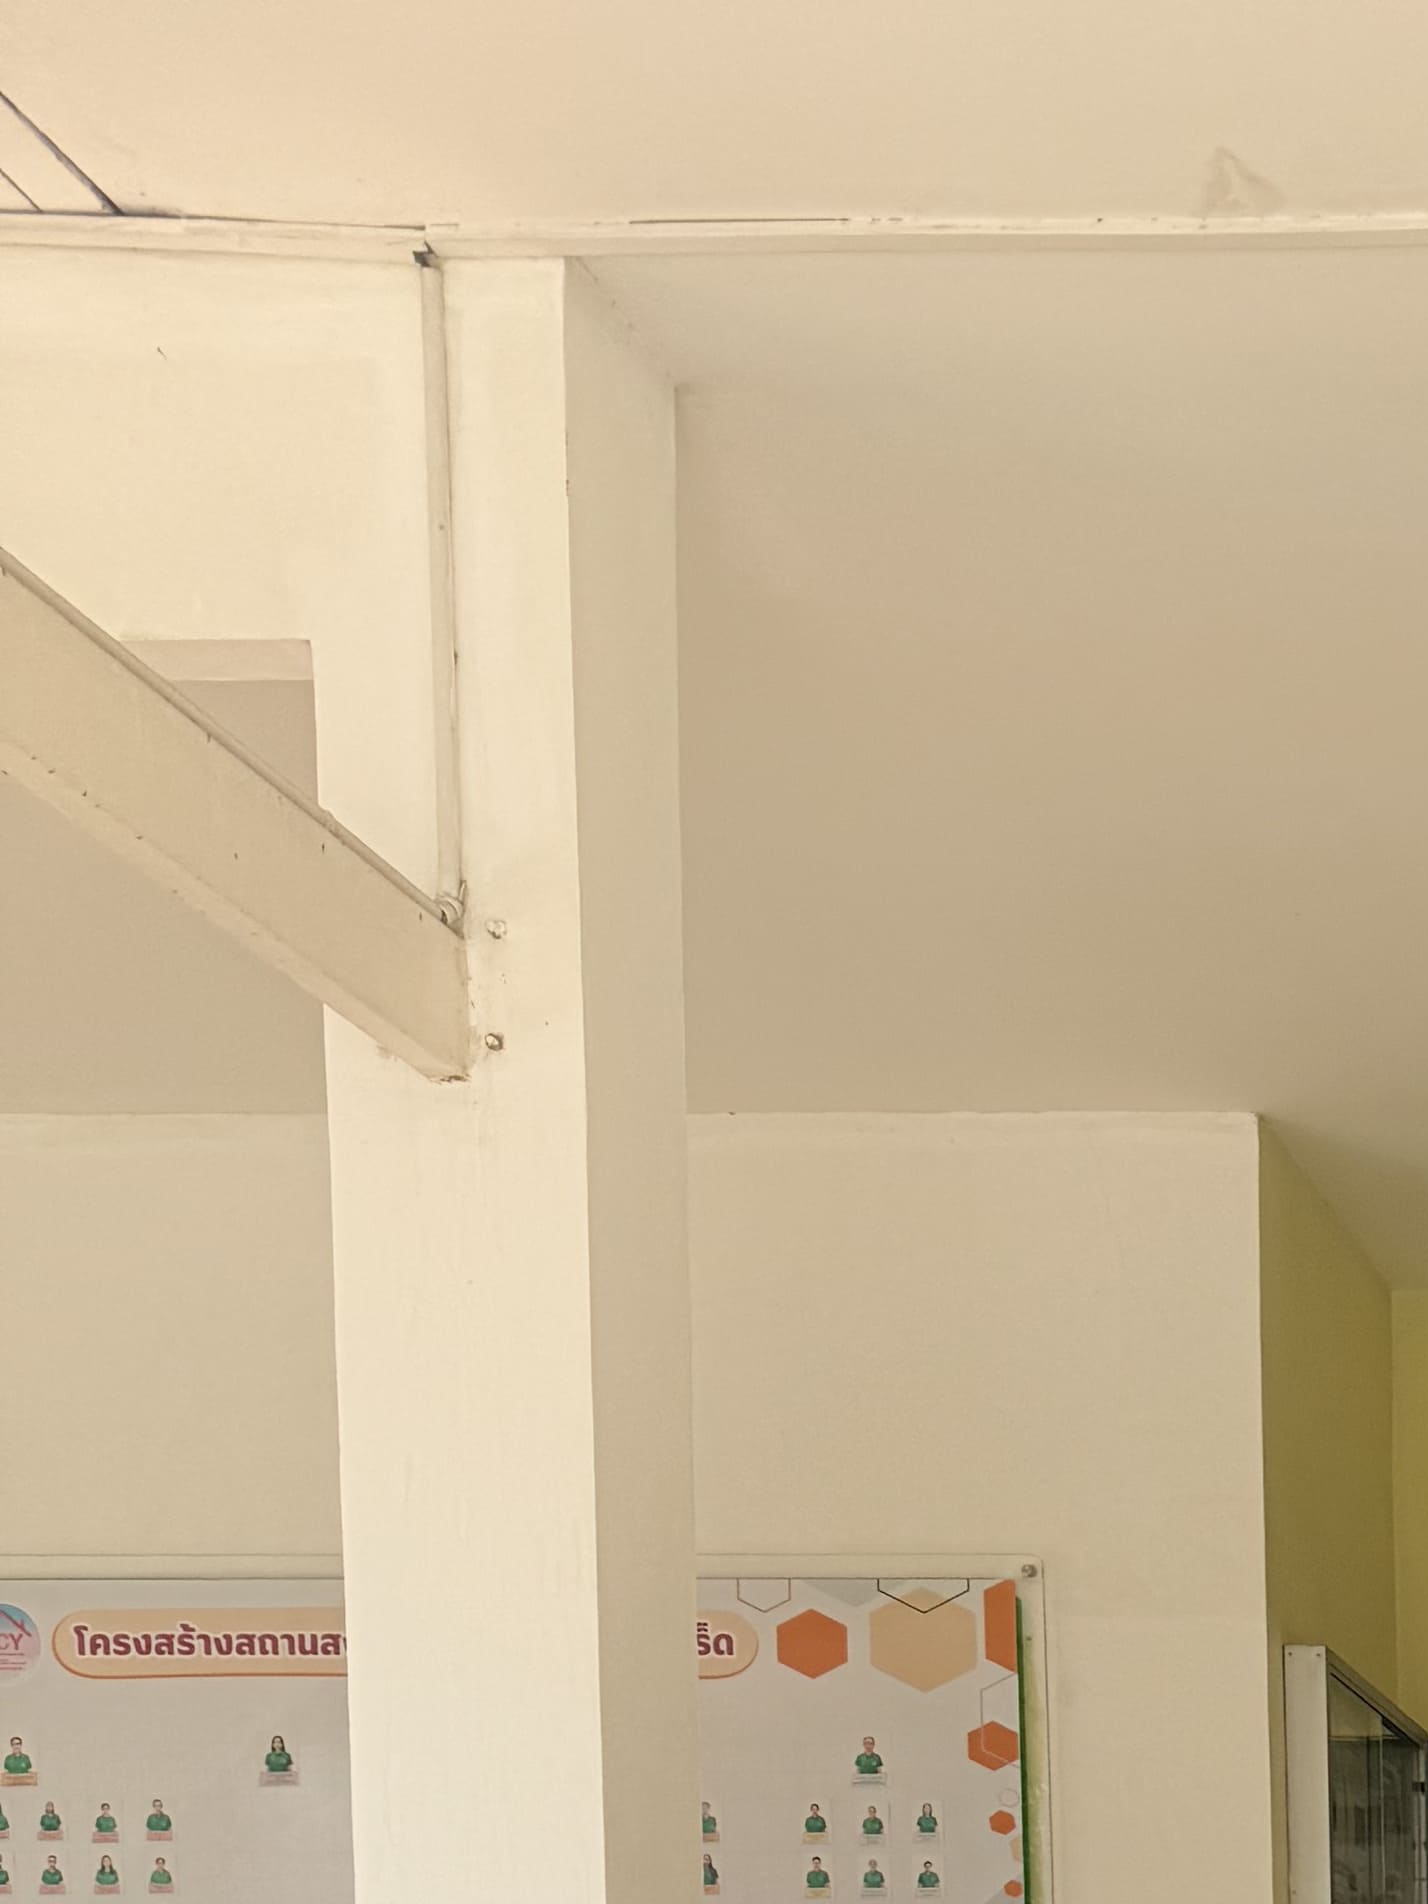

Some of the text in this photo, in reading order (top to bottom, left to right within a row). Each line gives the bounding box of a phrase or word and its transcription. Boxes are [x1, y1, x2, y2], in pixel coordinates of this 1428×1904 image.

[73, 1622, 347, 1658] โครงสร้างสถานส
